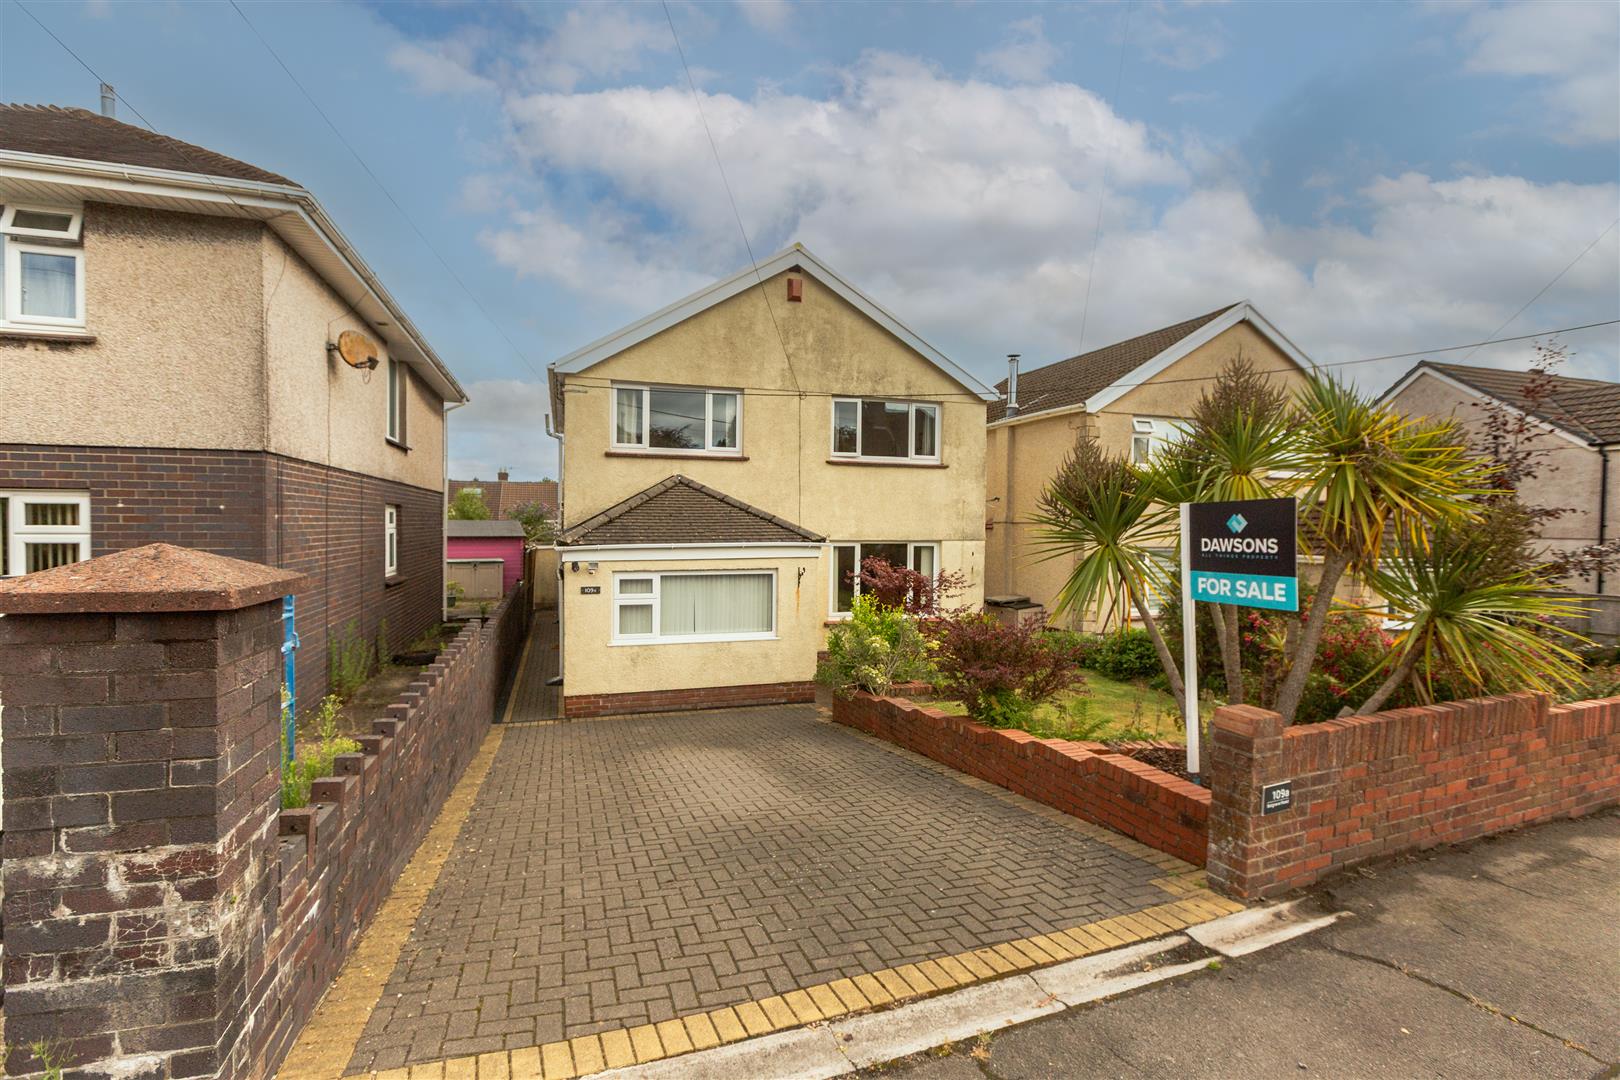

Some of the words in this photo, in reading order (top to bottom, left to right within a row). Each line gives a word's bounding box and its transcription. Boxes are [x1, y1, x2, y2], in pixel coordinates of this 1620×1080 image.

[1201, 538, 1279, 554] DAWSONS
[1197, 577, 1232, 597] FOR
[1235, 580, 1287, 602] SALE
